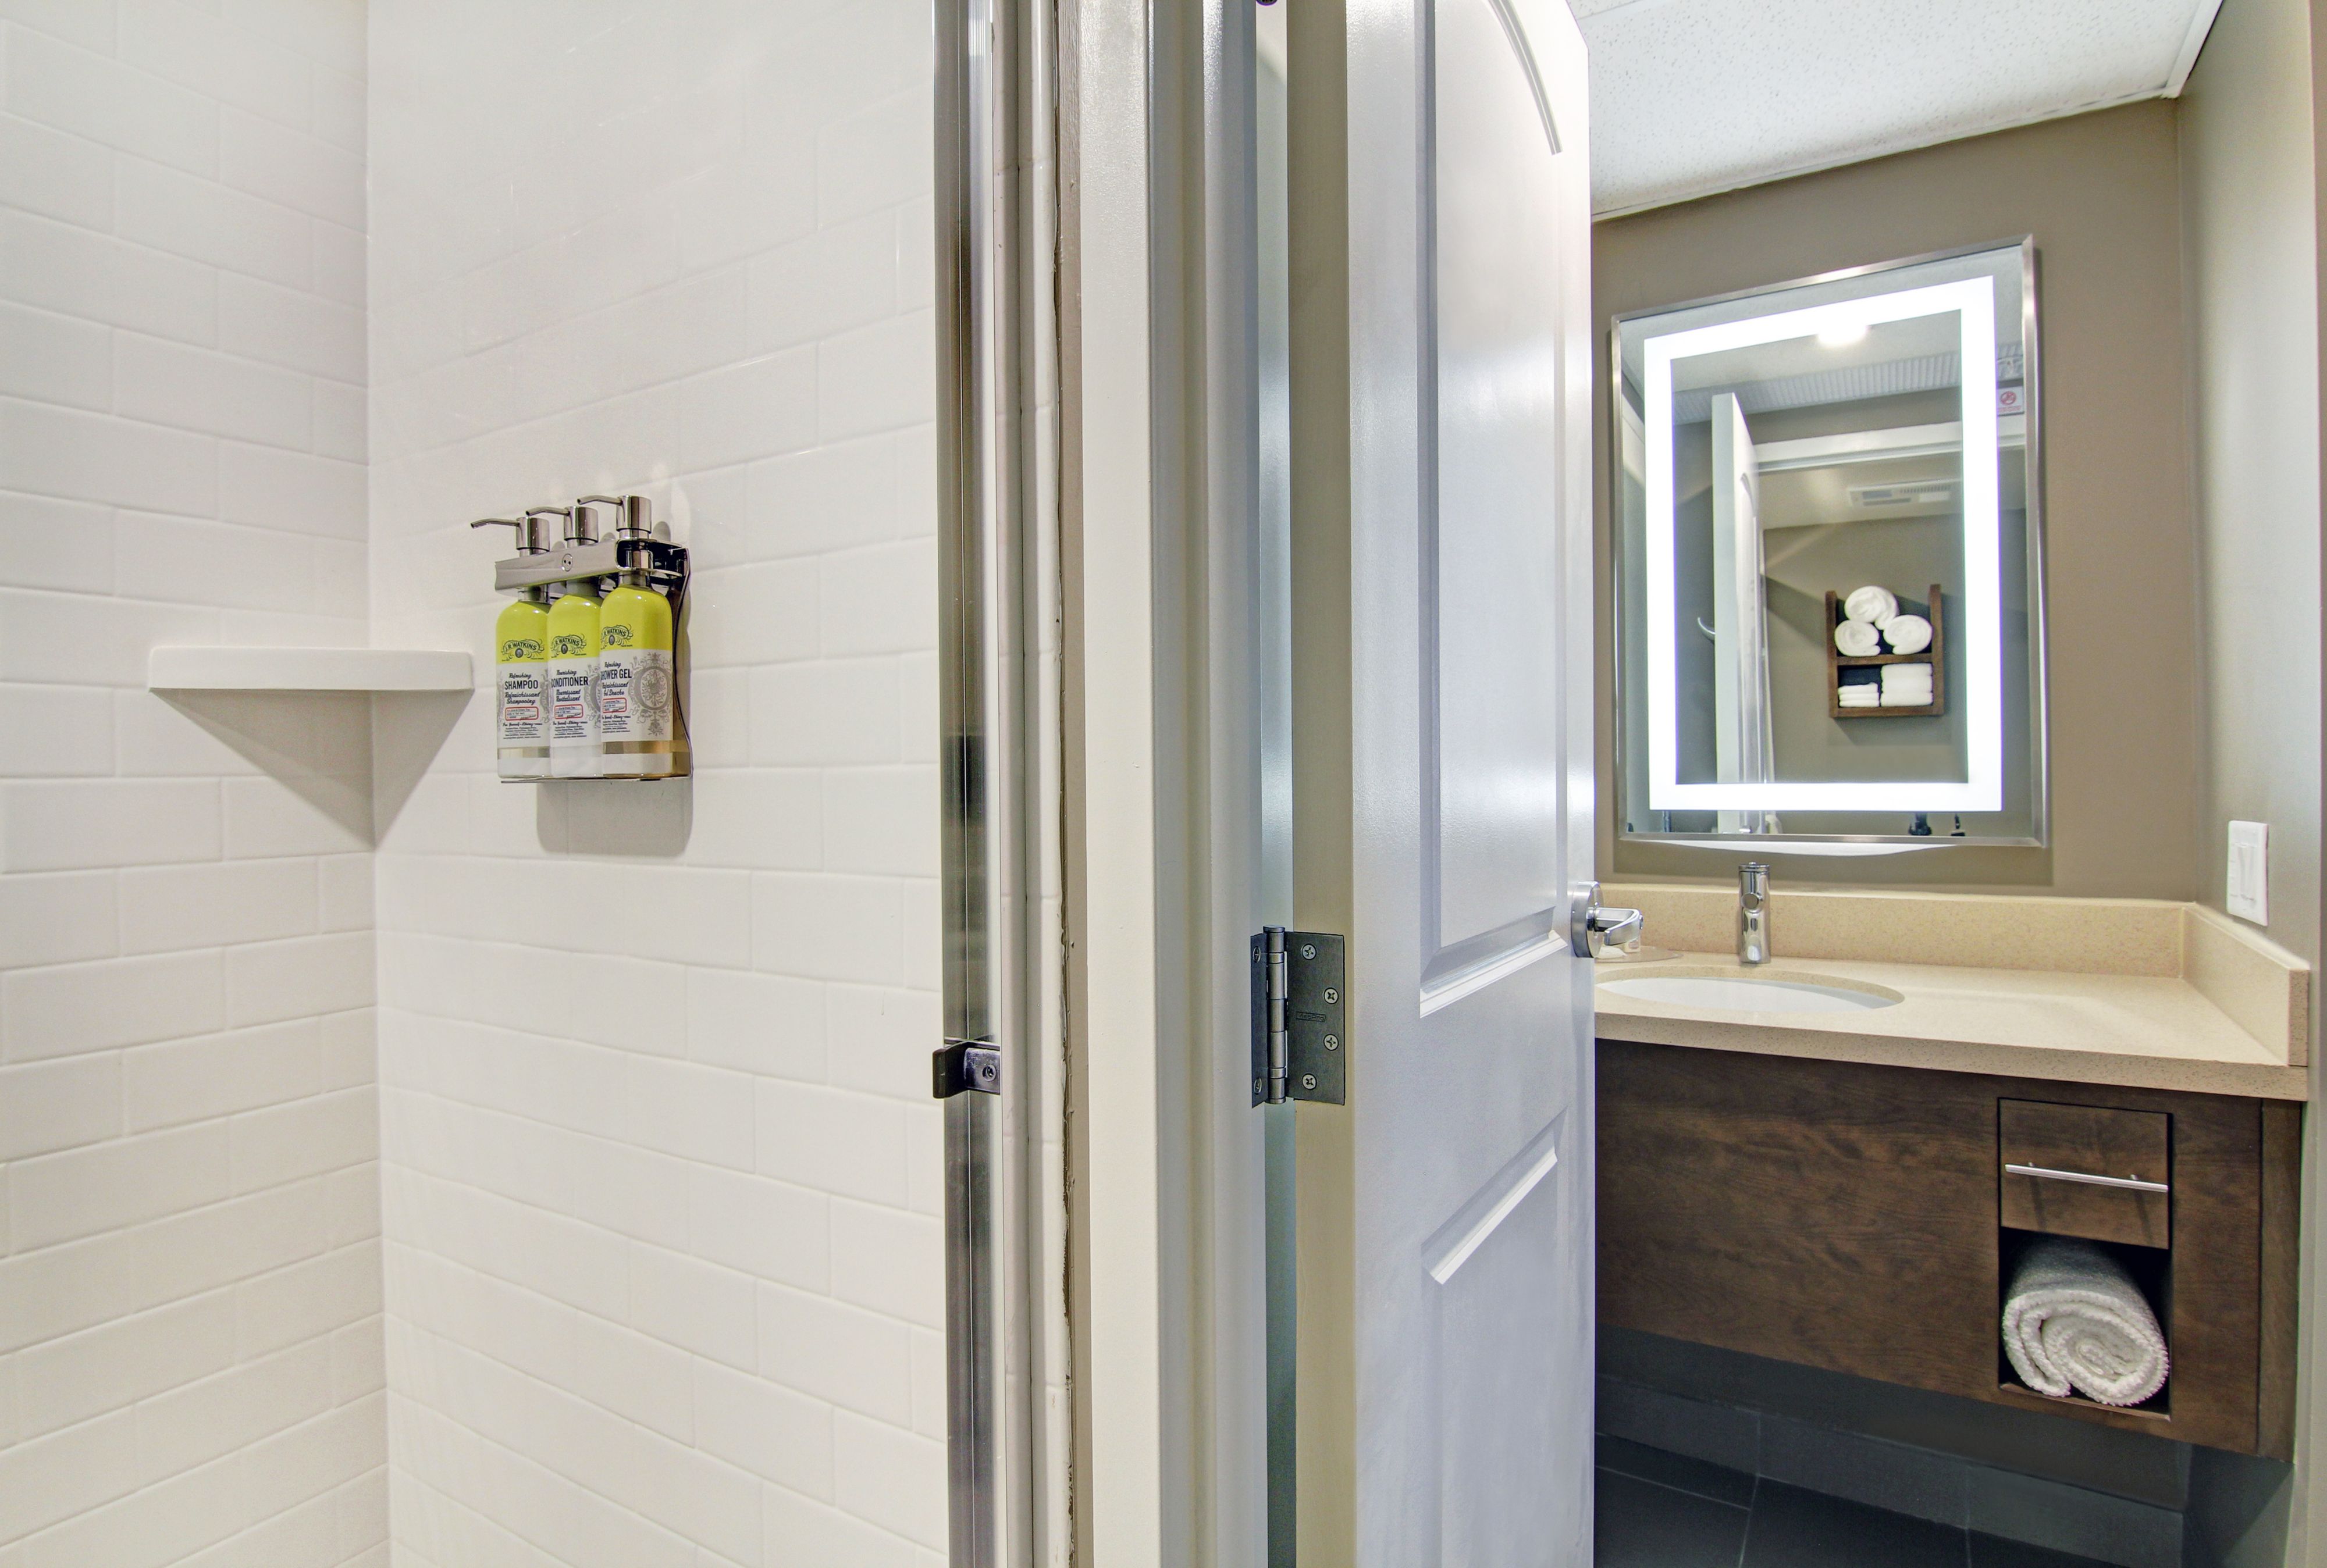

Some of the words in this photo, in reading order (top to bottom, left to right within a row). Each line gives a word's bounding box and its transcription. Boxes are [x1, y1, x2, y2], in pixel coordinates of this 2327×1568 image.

[512, 642, 537, 650] WATKINS
[558, 637, 580, 646] WATKINS
[619, 668, 632, 679] GEL
[504, 679, 539, 690] SHAMPOO
[551, 676, 588, 687] CONDITIONER
